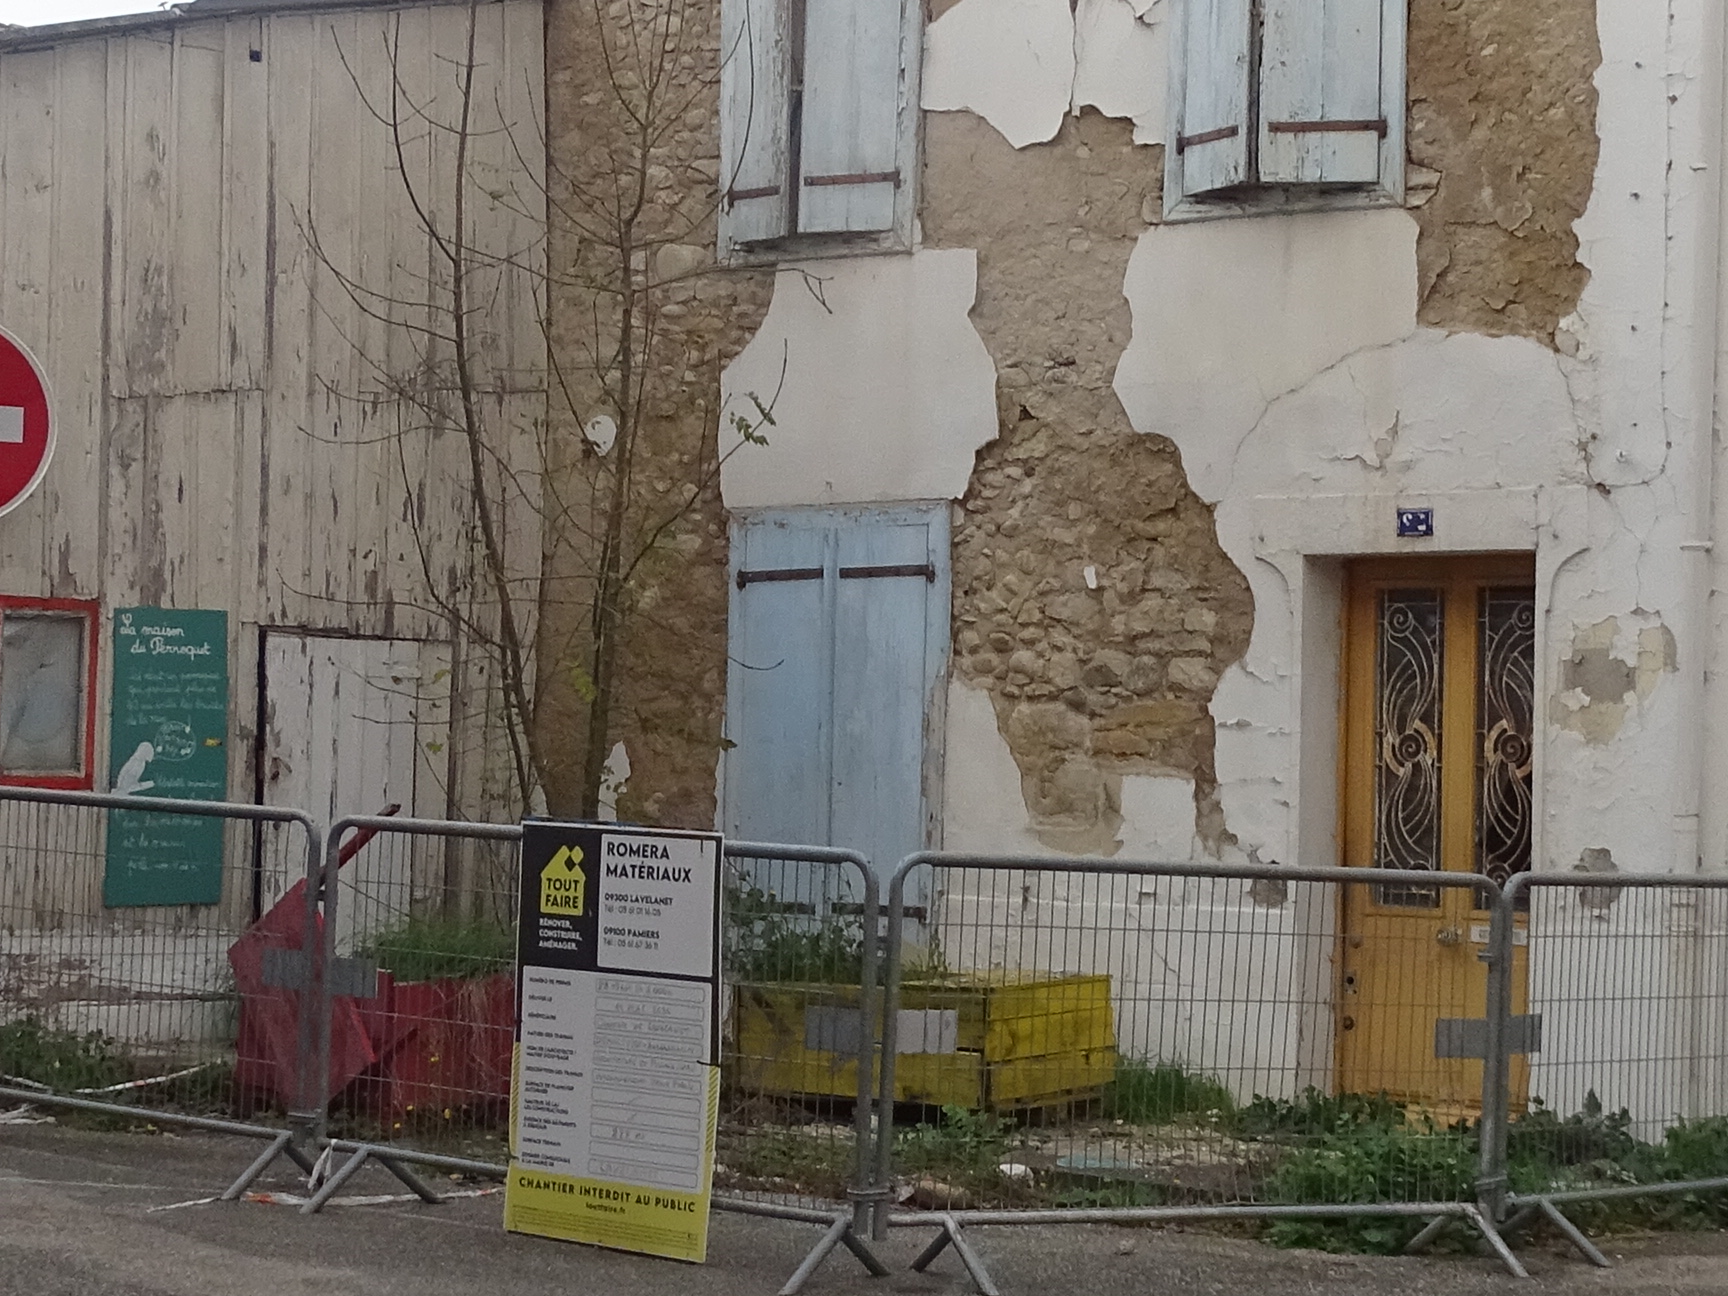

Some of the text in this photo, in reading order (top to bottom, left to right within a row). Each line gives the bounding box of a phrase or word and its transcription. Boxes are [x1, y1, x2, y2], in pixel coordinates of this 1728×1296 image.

[142, 622, 184, 636] maison
[131, 640, 146, 654] du
[607, 842, 669, 860] ROMERA
[606, 862, 692, 883] MATÉRIAUX
[546, 878, 580, 892] TOUT
[545, 894, 579, 909] FAIRE
[605, 893, 673, 906] 09300 LAVELANET
[539, 918, 573, 929] RÉNOVER,
[539, 929, 583, 941] CONSTRUIRE,
[628, 929, 660, 939] PAMIERS
[538, 940, 578, 950] AMÉNAGER.
[519, 1177, 696, 1212] CHANTIER INTERDIT AU PUBLIC
